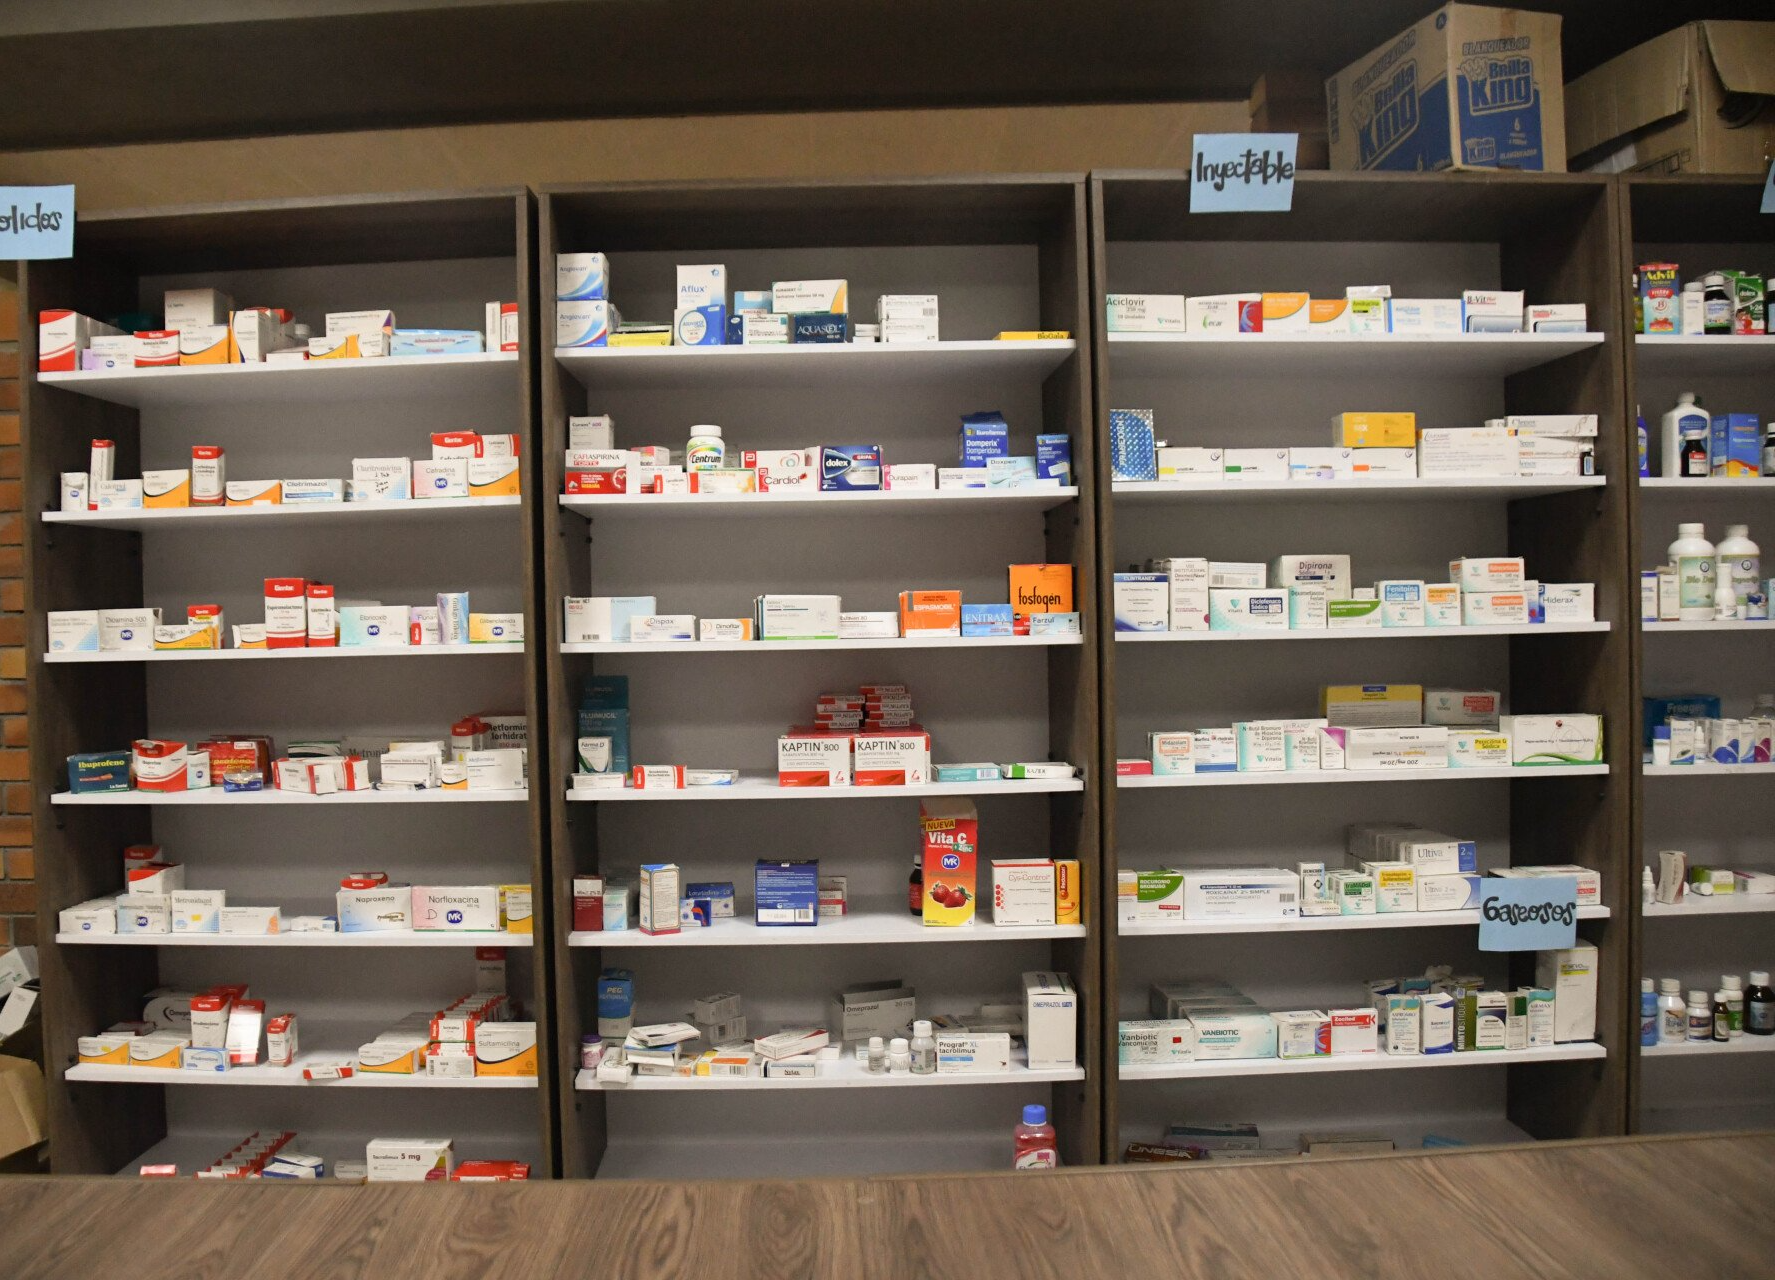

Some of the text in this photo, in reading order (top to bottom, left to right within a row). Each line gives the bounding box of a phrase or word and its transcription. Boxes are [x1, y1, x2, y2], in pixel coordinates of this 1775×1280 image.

[1196, 148, 1294, 192] Inyectable
[1646, 270, 1676, 281] Advil
[681, 285, 706, 293] Aflux
[1106, 296, 1145, 308] Aciclovir
[691, 455, 722, 465] Centrum
[825, 458, 849, 467] dolex
[764, 476, 801, 485] Cardiol
[1299, 561, 1333, 571] Dipirona
[965, 612, 1008, 623] ENITRAX
[823, 743, 840, 751] 800
[899, 742, 915, 750] 800
[78, 759, 125, 769] Ibuprofeno
[927, 820, 955, 830] NUEVA
[928, 832, 967, 845] Vita C
[944, 857, 957, 867] MK
[355, 895, 395, 903] Naproxeno
[428, 895, 479, 904] Norfloxacina
[447, 912, 462, 922] MK
[846, 1004, 880, 1013] Omeprazol
[478, 1040, 520, 1048] Sultamicilina
[401, 1152, 406, 1160] 5
[408, 1152, 421, 1162] mg
